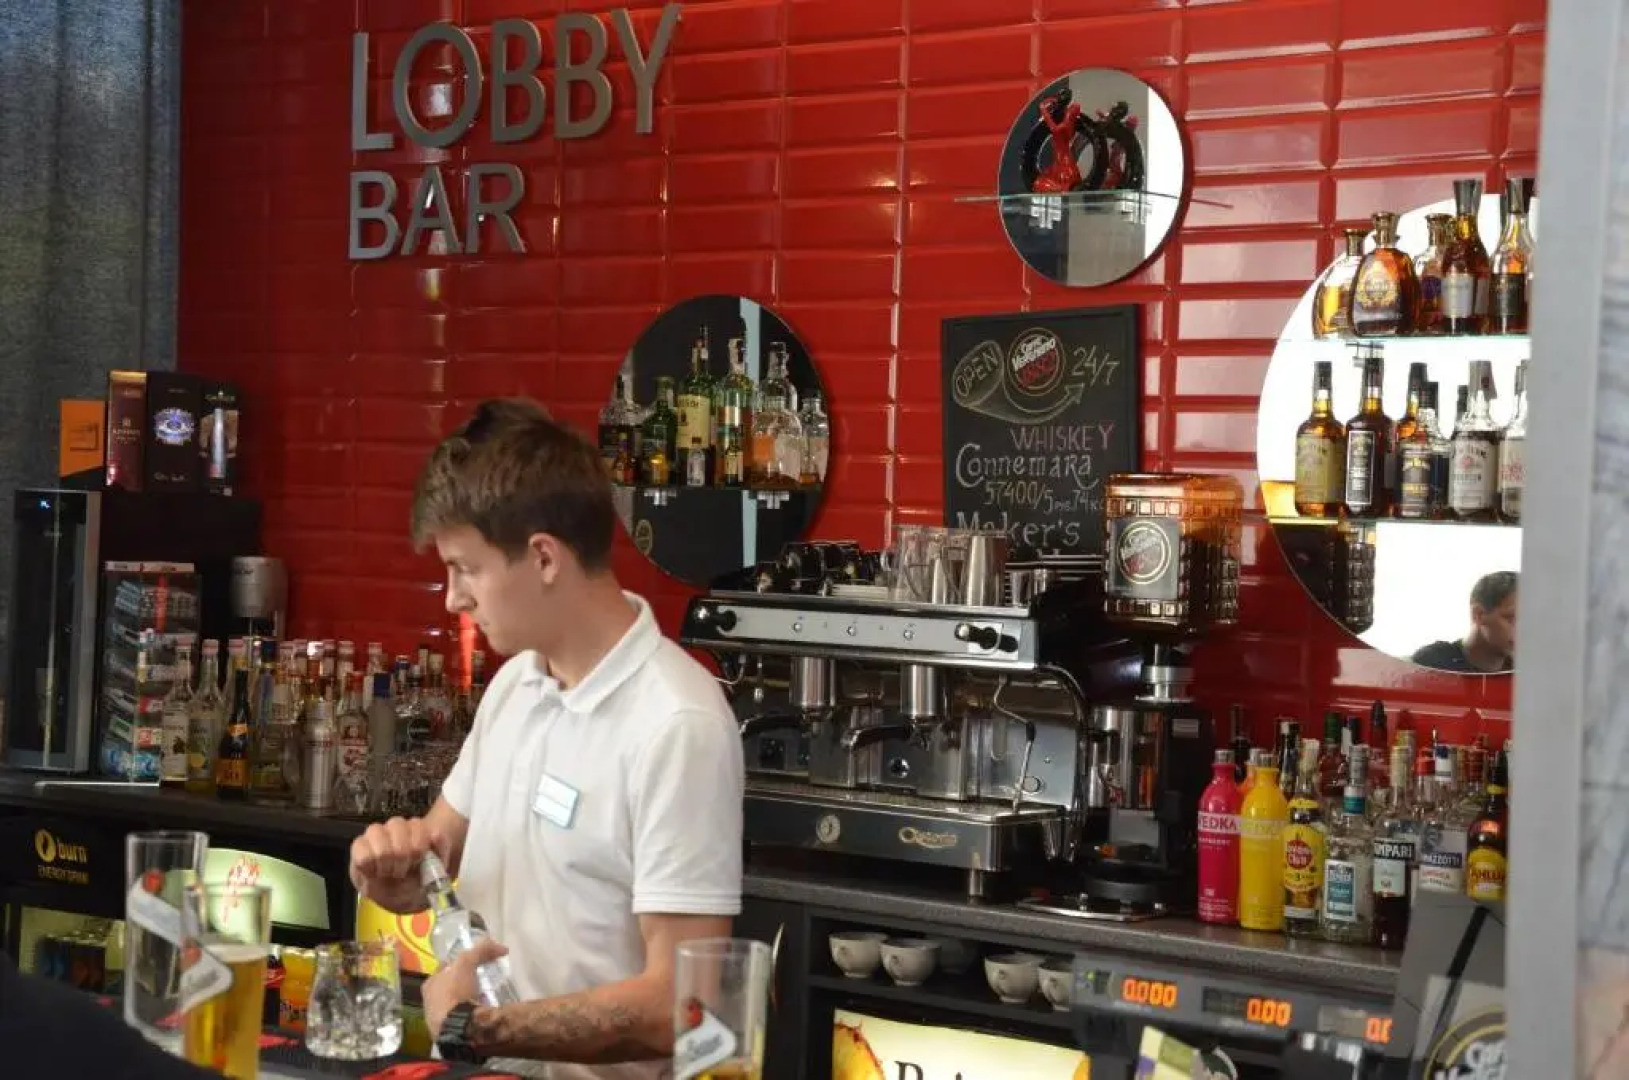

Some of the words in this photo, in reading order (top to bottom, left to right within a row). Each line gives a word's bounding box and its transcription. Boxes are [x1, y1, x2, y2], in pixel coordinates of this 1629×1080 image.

[351, 3, 683, 151] LOBBY
[347, 161, 528, 260] BAR
[954, 348, 1000, 397] OPEN
[1072, 345, 1120, 387] 24/7
[1011, 421, 1115, 451] WHISKEY
